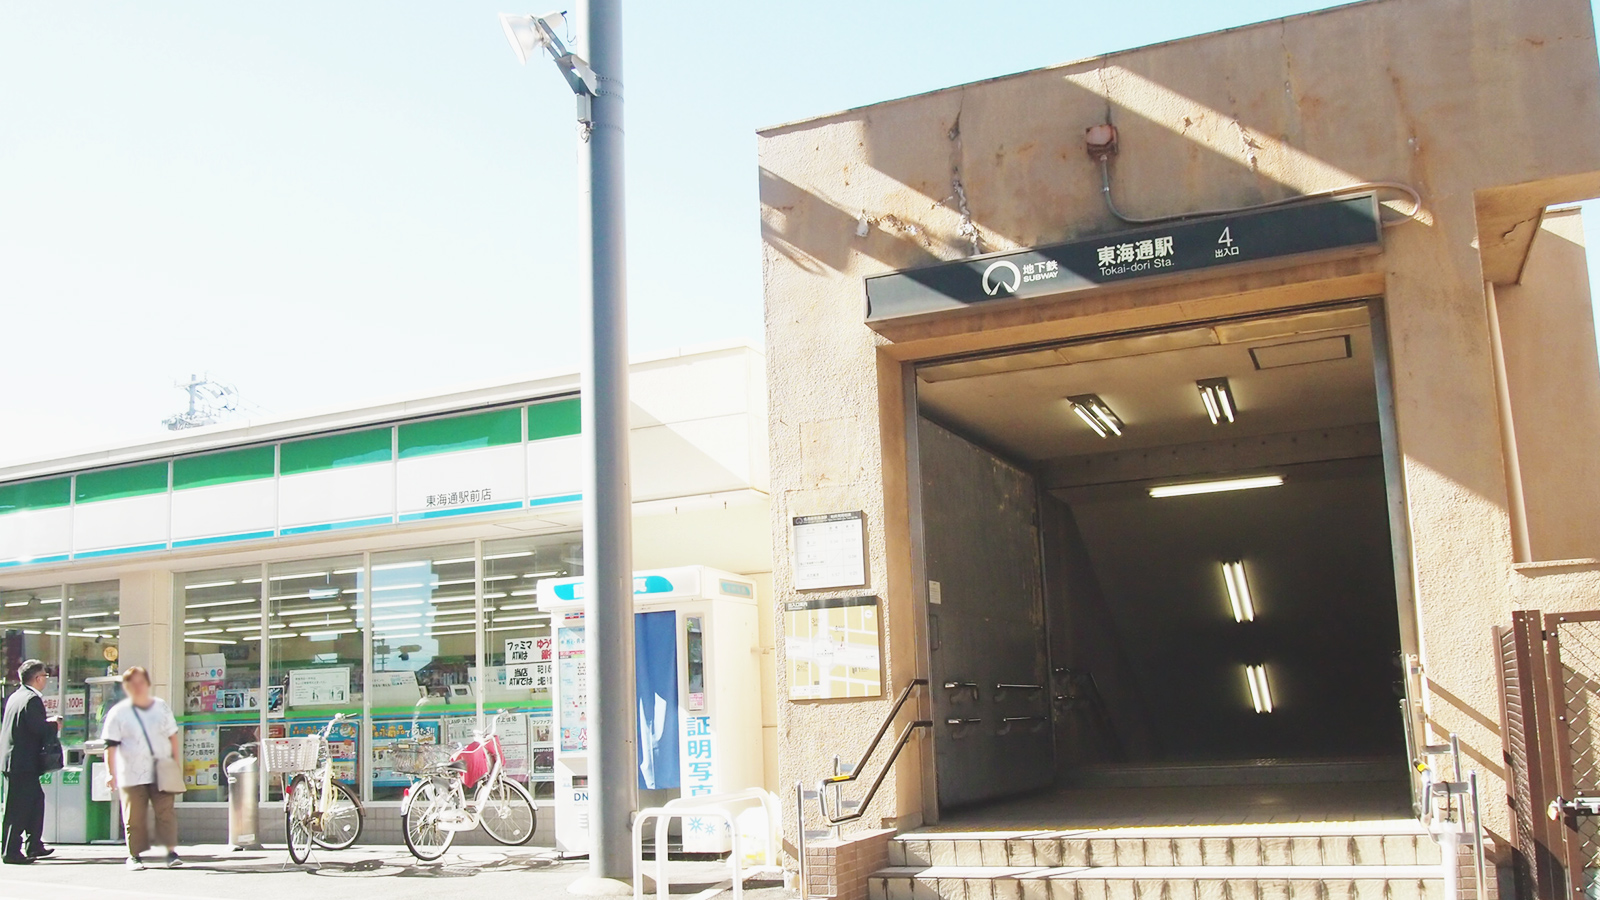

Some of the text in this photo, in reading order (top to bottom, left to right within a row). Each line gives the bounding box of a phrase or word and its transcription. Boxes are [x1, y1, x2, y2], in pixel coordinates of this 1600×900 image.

[1217, 226, 1234, 248] 4
[1097, 235, 1174, 266] 東海通駅
[1214, 246, 1240, 257] 出入口
[1022, 259, 1059, 275] 地下鉄
[1100, 258, 1175, 277] Tokai-dori Sta.
[1023, 270, 1059, 284] SUBWAY
[426, 488, 492, 507] 東海通駅前店
[507, 640, 533, 650] ファミマ
